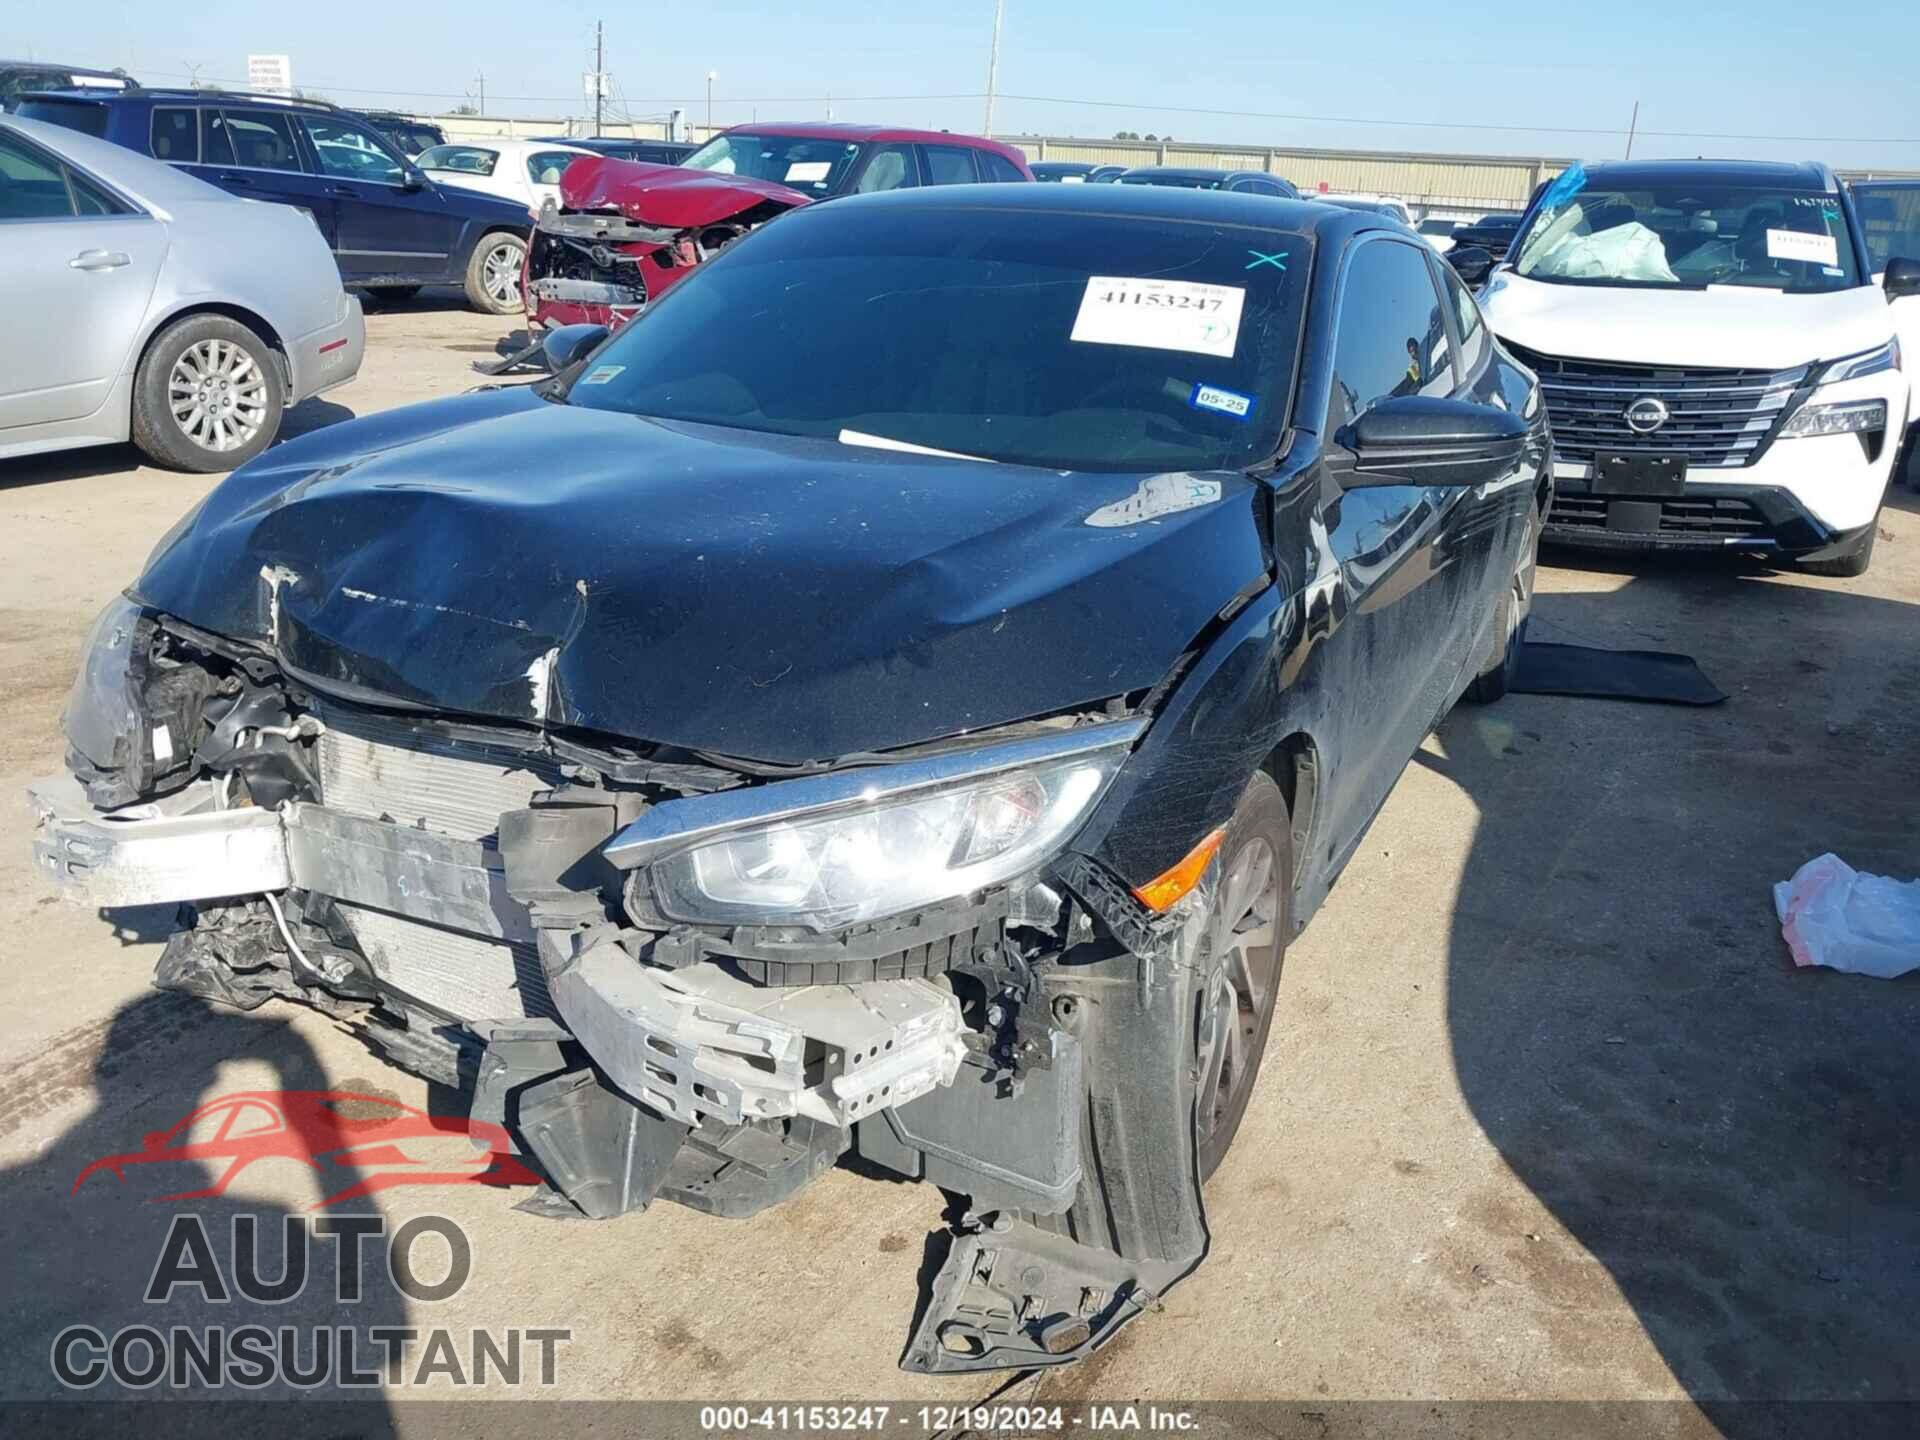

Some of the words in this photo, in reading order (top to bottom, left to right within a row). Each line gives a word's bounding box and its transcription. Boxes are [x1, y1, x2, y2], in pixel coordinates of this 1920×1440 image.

[1099, 290, 1223, 312] 41153247
[1200, 392, 1245, 411] 05-25
[1623, 411, 1669, 420] NISSAN
